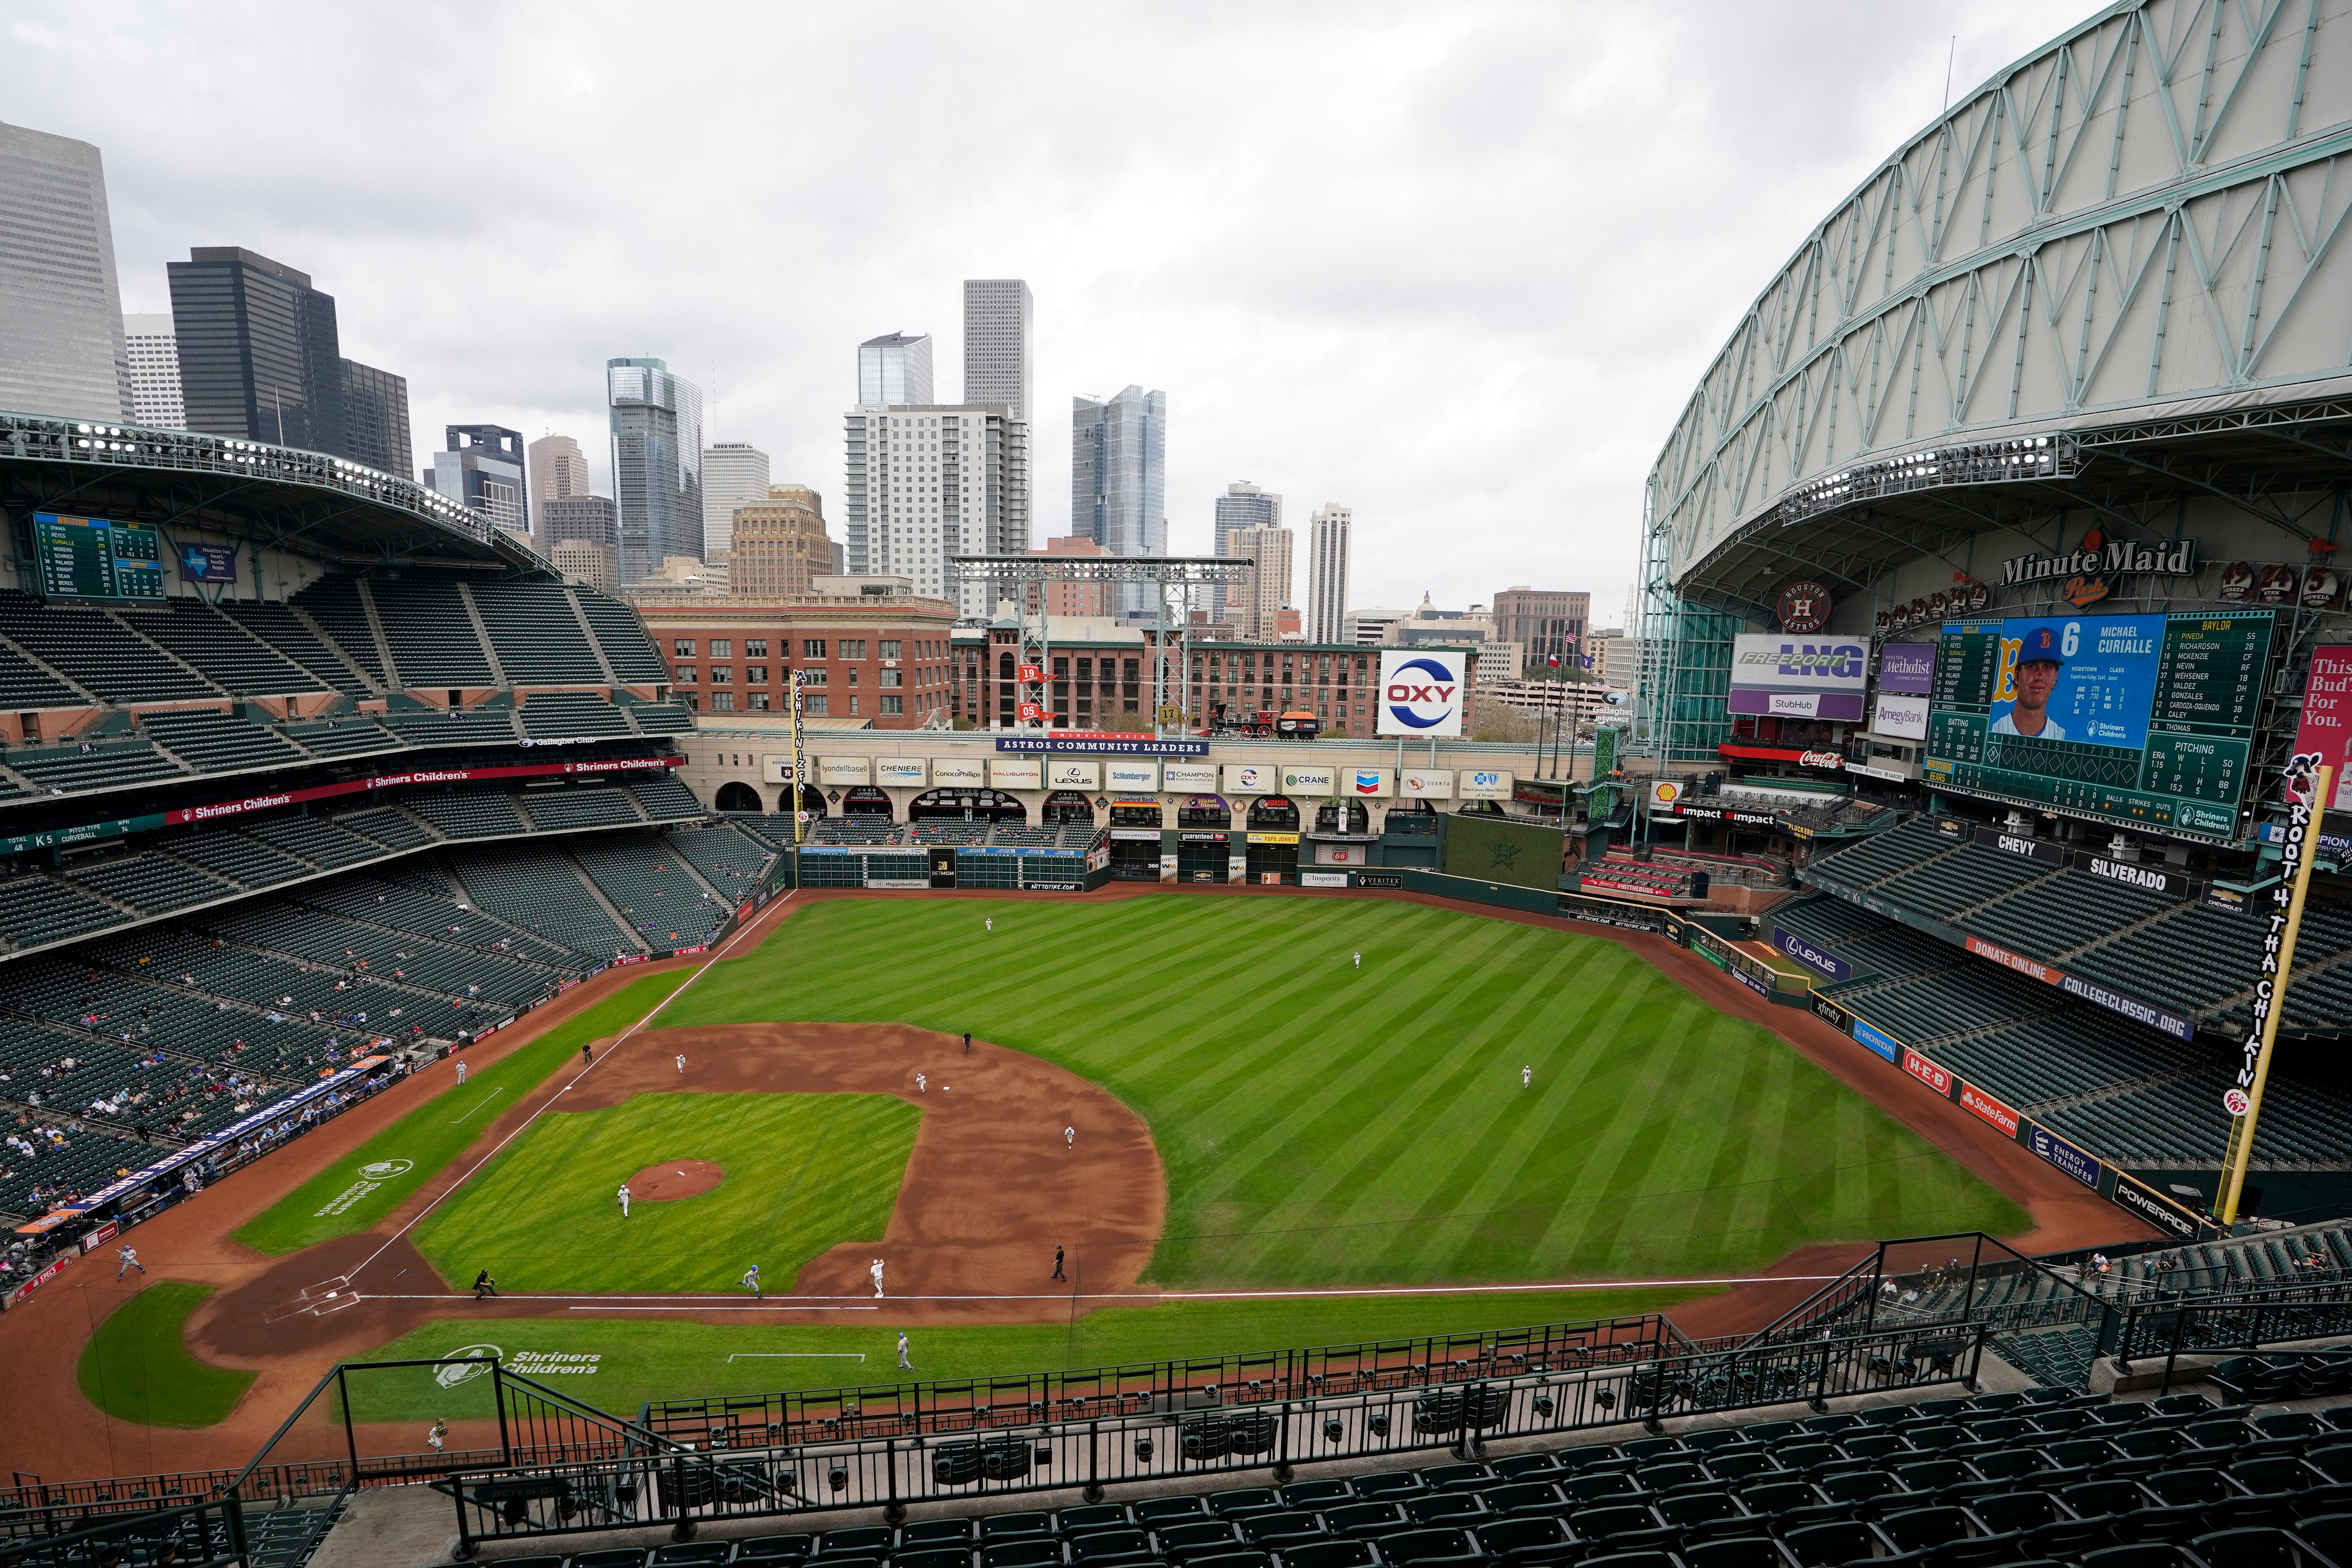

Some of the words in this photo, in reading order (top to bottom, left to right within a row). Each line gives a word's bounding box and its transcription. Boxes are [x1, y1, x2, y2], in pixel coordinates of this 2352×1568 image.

[2000, 548, 2097, 586] Minute
[2103, 541, 2190, 572] Maid
[1786, 584, 1825, 598] HOUSTON
[2063, 578, 2108, 600] Park
[1784, 618, 1820, 630] ASTROS
[2202, 621, 2231, 631] BAYLOR
[2101, 627, 2137, 637] MICHAEL
[2061, 622, 2081, 657] 6
[2099, 639, 2153, 654] CURIALLE
[1742, 653, 1844, 666] FREEPORT
[1778, 644, 1864, 678] LNG
[1884, 659, 1930, 674] Methodist
[2315, 658, 2352, 675] This
[1023, 668, 1034, 678] 19
[2310, 676, 2352, 693] Bud'
[1388, 685, 1456, 703] OXY
[2171, 692, 2203, 700] GONZALES
[2307, 693, 2338, 709] For
[1592, 706, 1634, 716] Gallagher
[1775, 700, 1812, 709] StubHub
[2170, 701, 2220, 711] CARDOZA-OQUENDO
[794, 692, 803, 748] CHIKIN
[1163, 709, 1174, 718] 17
[1878, 707, 1923, 725] AmegyBank
[2305, 710, 2342, 727] You.
[1948, 718, 1968, 727] BATTING
[2099, 723, 2125, 732] Shriners
[2166, 723, 2191, 732] THOMAS
[2099, 730, 2126, 739] Children's
[1004, 741, 1051, 749] ASTROS
[1057, 742, 1138, 751] COMMUNITY
[1144, 744, 1201, 752] LEADERS
[2175, 742, 2214, 755] PITCHING
[576, 762, 619, 772] Shriners
[620, 759, 665, 769] Children's
[797, 750, 805, 769] IZ
[822, 764, 867, 772] lyondellbasell
[375, 774, 411, 787] Shriners
[413, 771, 468, 782] Children's
[1113, 772, 1151, 782] Schlumberger
[1929, 771, 1946, 782] BEARS
[1267, 799, 1288, 807] apache
[2106, 794, 2123, 803] BALLS
[2128, 798, 2151, 808] STRIKES
[196, 804, 242, 819] Shriners
[243, 793, 290, 811] Children's
[1683, 806, 1721, 818] impact
[2156, 803, 2171, 811] OUTS
[1734, 811, 1774, 825] impact
[2196, 810, 2228, 822] Shriners
[1789, 823, 1813, 837] PLUCKERS
[2195, 818, 2230, 831] Children's
[7, 836, 27, 844] TOTAL
[61, 832, 96, 843] CURVEBALL
[2282, 805, 2308, 878] ROOT
[1998, 835, 2036, 856] CHEVY
[2090, 858, 2166, 891] SILVERADO
[1617, 883, 1653, 894] #HITTHEBUDS
[2273, 888, 2289, 907] 4
[2208, 900, 2243, 913] CHEVROLET
[2262, 915, 2286, 973] THA
[1798, 945, 1836, 973] LEXUS
[1975, 941, 2010, 965] DONATE
[2011, 956, 2046, 980] ONLINE
[1766, 972, 1775, 981] 370
[1818, 1002, 1840, 1024] xfinity
[2064, 976, 2185, 1037] COLLEGECLASSIC.ORG
[498, 1015, 515, 1030] marucci
[2237, 981, 2272, 1087] CHIKIN
[1862, 1030, 1894, 1054] HONDA
[148, 1140, 219, 1170] COLLEGE
[2054, 1143, 2086, 1168] ENERGY
[2053, 1153, 2092, 1183] TRANSFER
[79, 1171, 154, 1204] CLASSIC
[331, 1182, 381, 1215] Shriners
[2118, 1184, 2193, 1235] POWERADE
[513, 1351, 602, 1362] Shriners
[492, 1488, 536, 1497] SECTION
